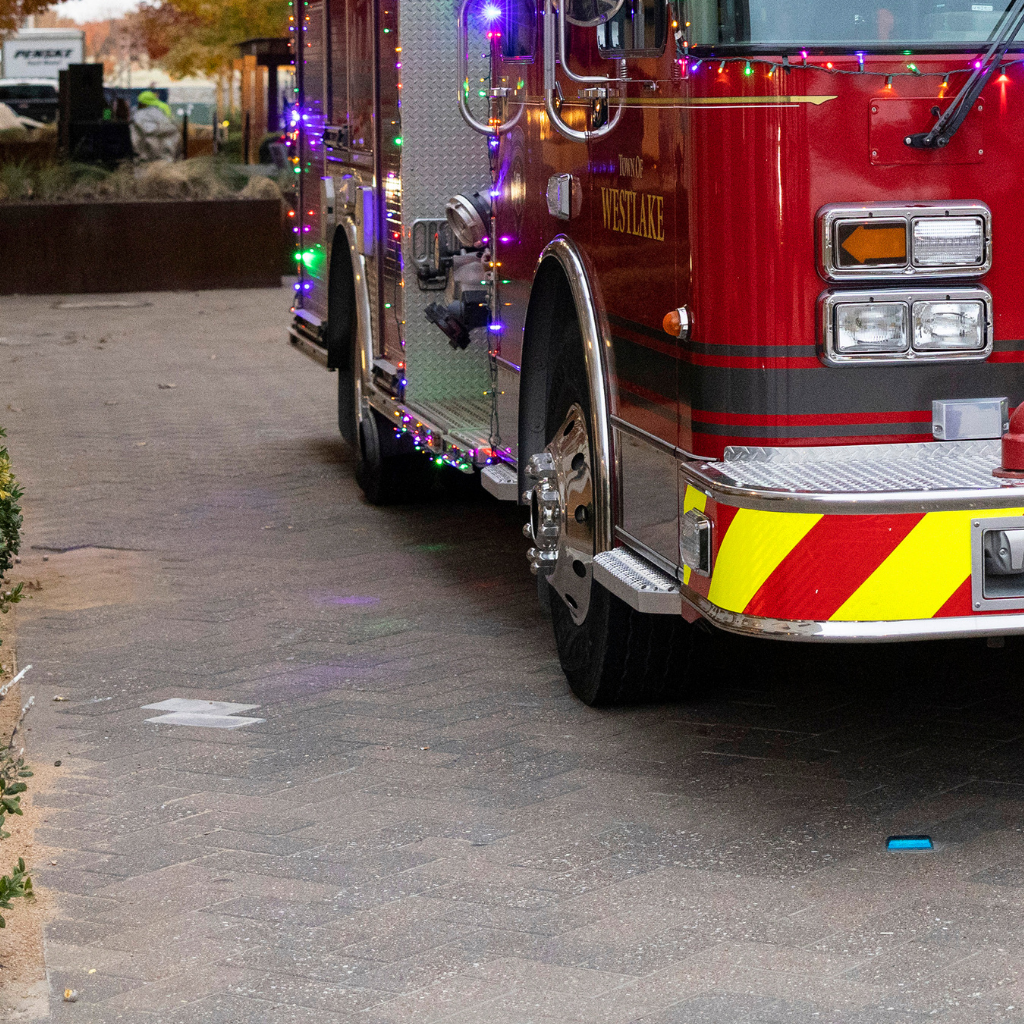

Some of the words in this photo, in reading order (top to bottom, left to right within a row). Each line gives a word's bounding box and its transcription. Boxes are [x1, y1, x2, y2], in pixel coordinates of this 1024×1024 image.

[618, 154, 635, 177] TOWN
[636, 155, 643, 179] OF
[601, 186, 665, 242] WESTLAKE
